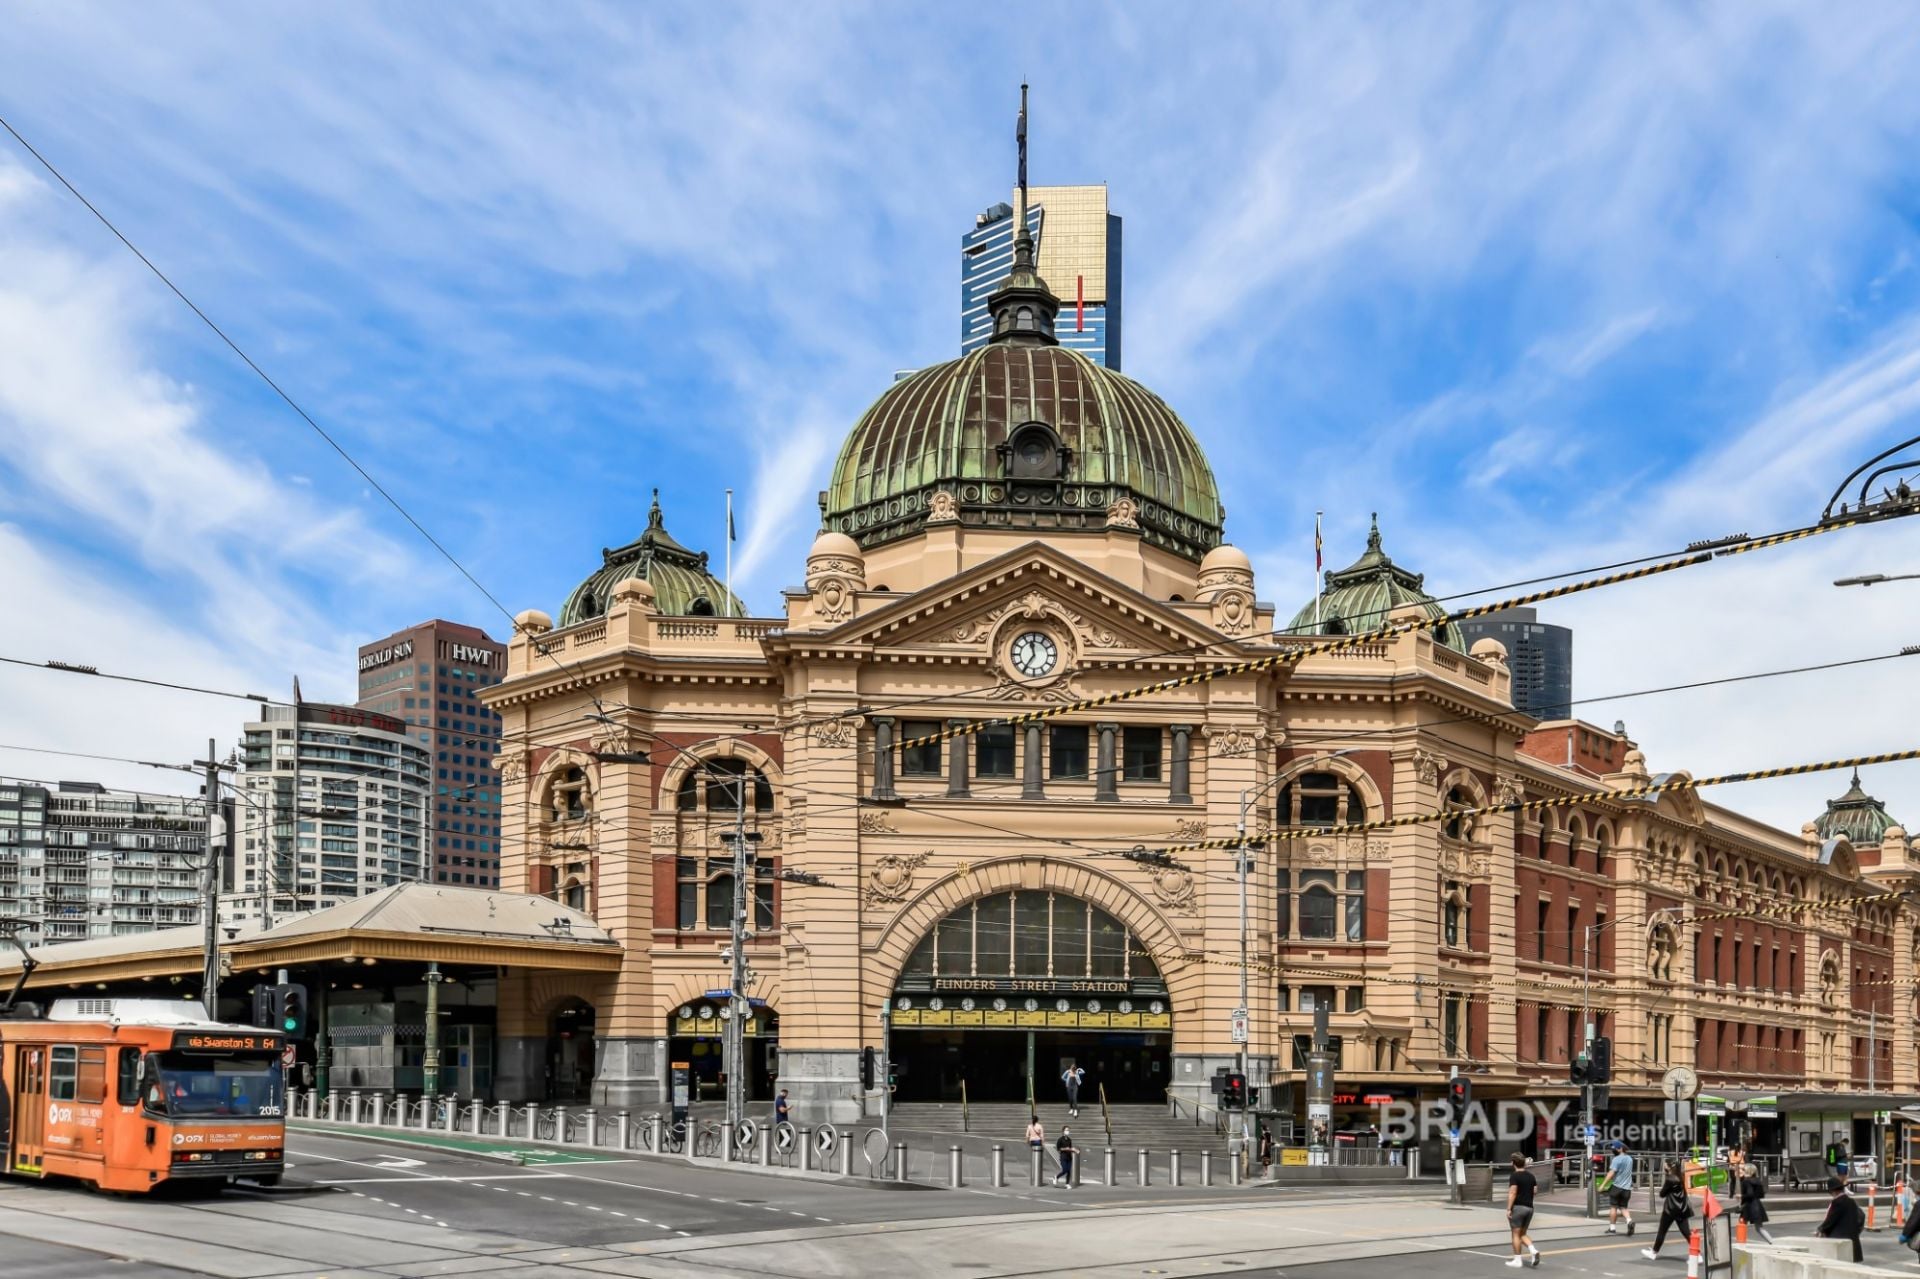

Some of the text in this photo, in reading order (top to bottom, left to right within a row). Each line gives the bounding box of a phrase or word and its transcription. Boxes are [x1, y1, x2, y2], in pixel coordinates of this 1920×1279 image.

[358, 640, 412, 670] HERALD SUN
[453, 643, 492, 665] HWT
[935, 979, 1128, 992] FLINDERS STREET STATION
[189, 1036, 275, 1049] via Swanston St 64
[259, 1106, 281, 1115] 2015
[185, 1133, 204, 1143] OFX
